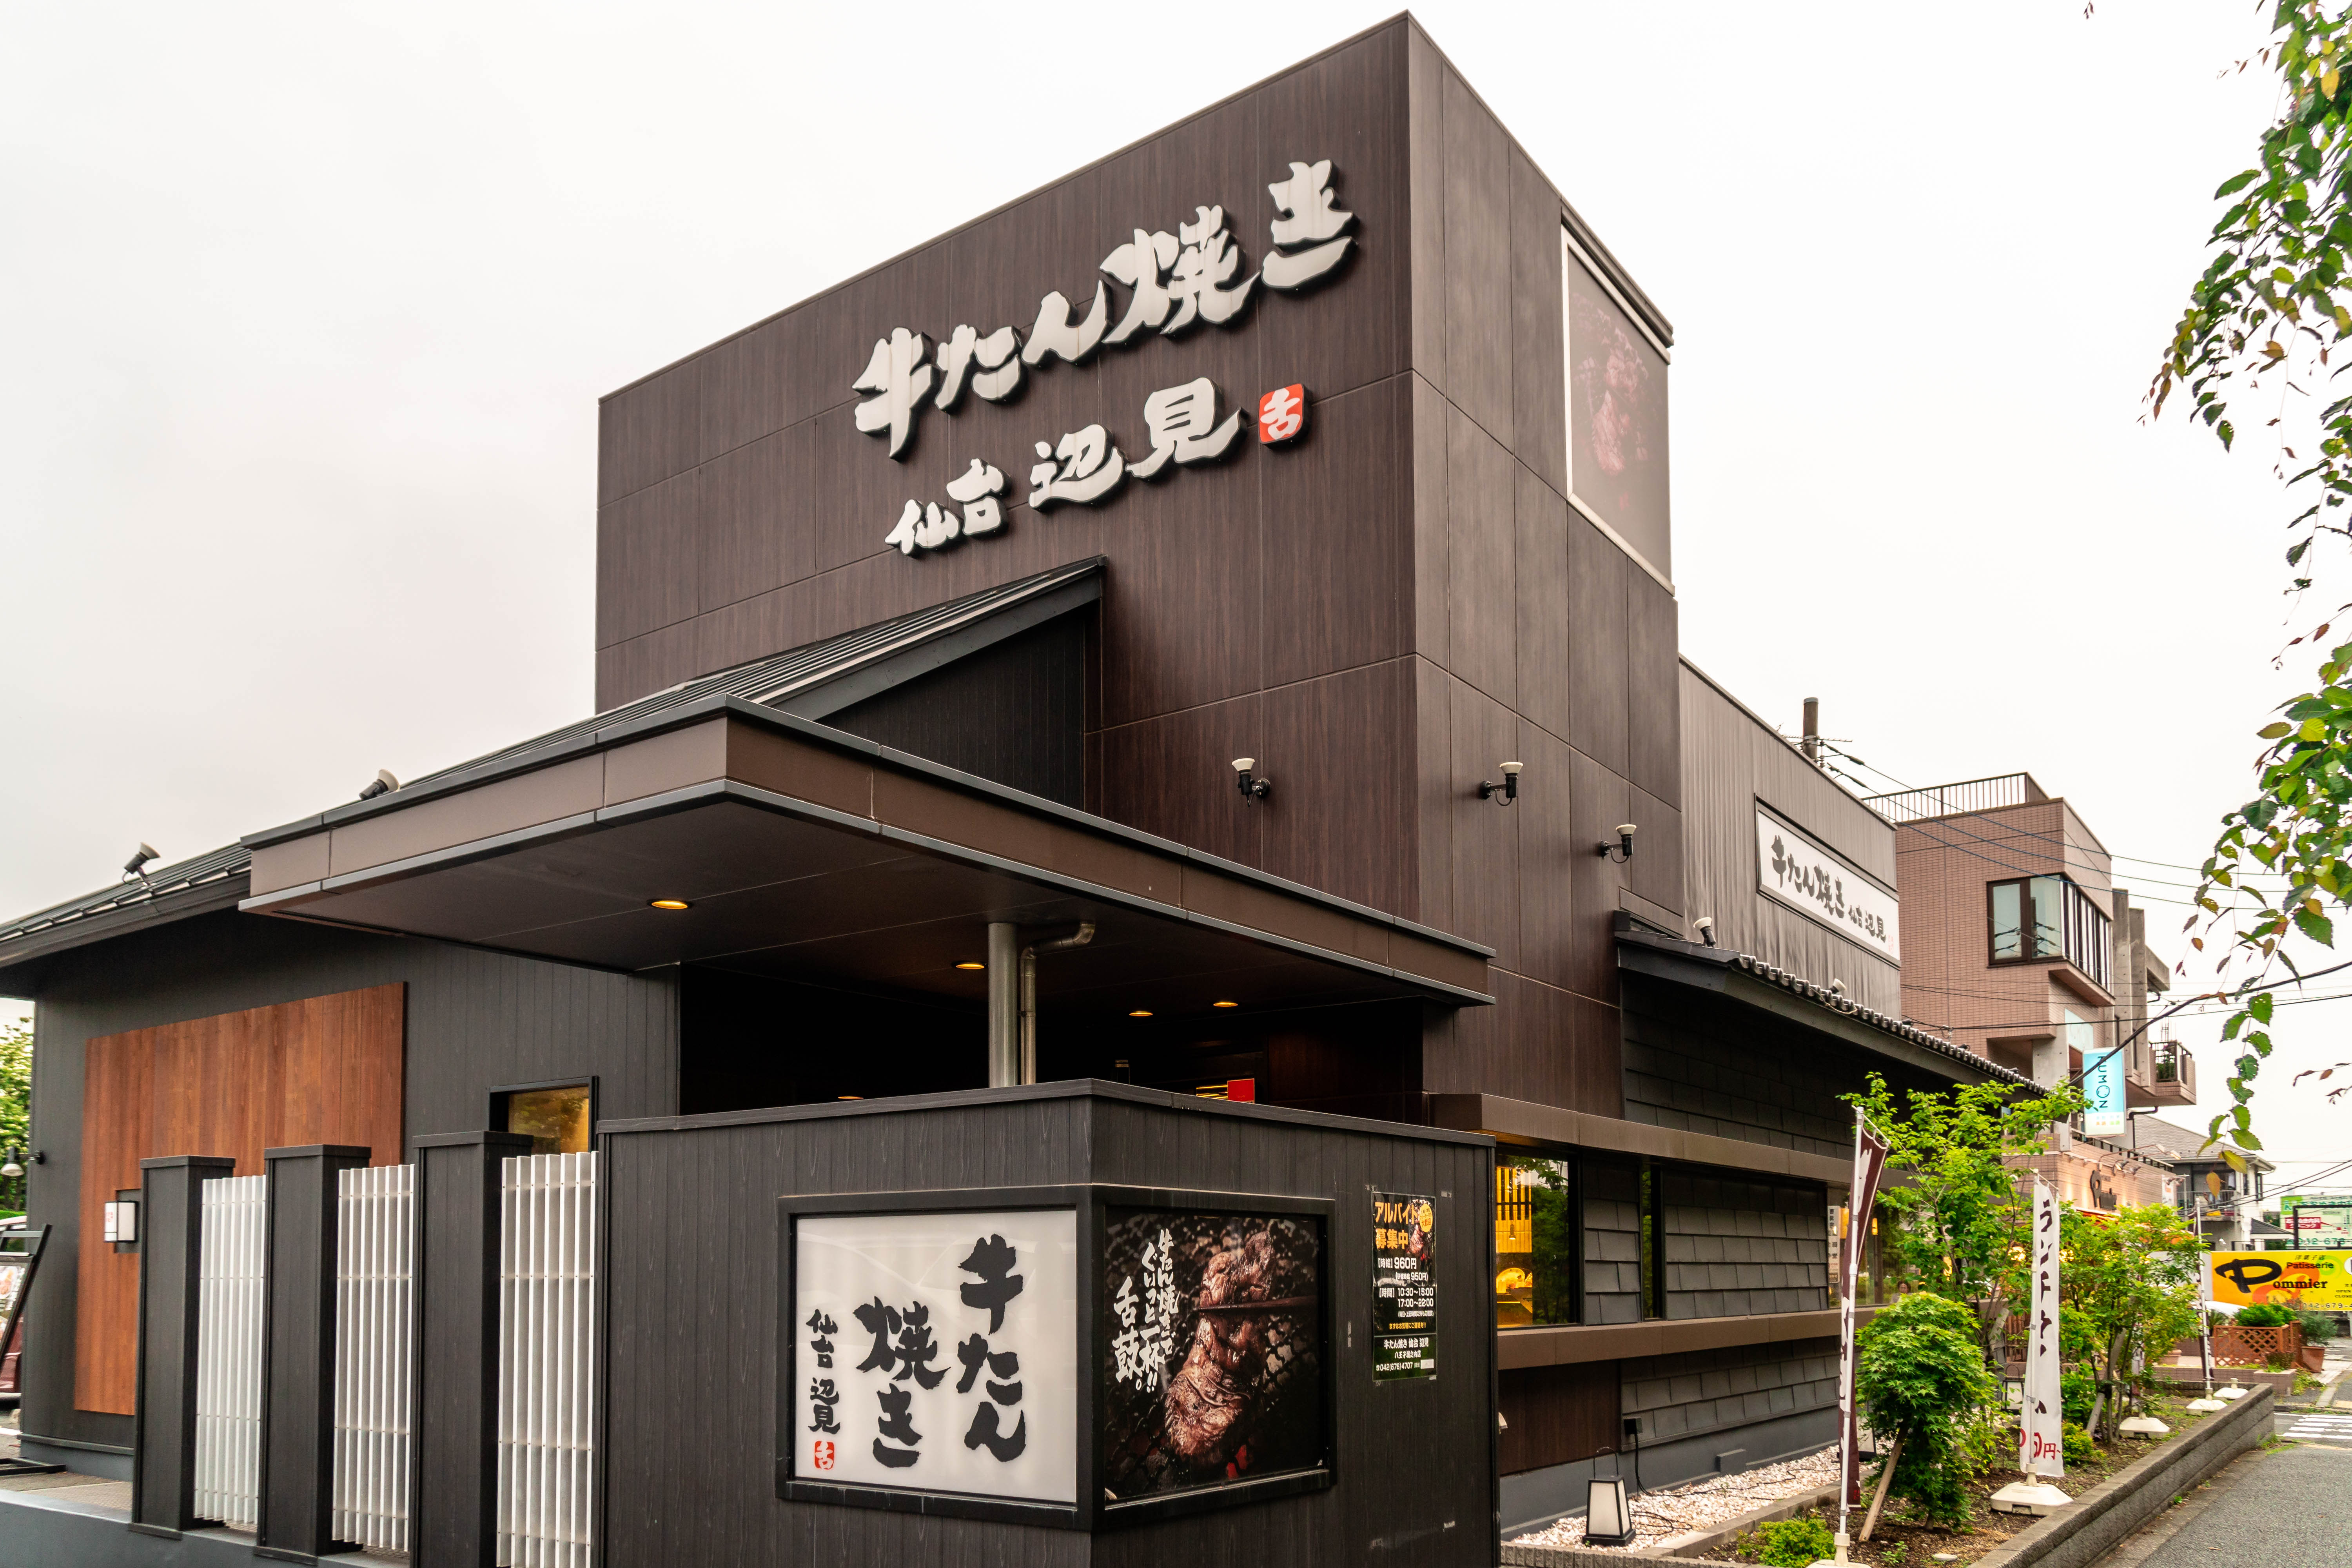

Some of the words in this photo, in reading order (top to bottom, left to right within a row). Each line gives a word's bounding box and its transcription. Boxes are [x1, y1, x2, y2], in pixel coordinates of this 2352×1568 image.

[851, 159, 1354, 459] 牛たん焼き
[1771, 835, 1845, 918] 牛たん焼き
[1375, 1202, 1418, 1225] アルバイト
[1375, 1228, 1408, 1249] 募集中
[956, 1234, 1026, 1462] 牛たん
[1156, 1228, 1181, 1355] 牛たん焼きで
[852, 1296, 951, 1468] 焼き
